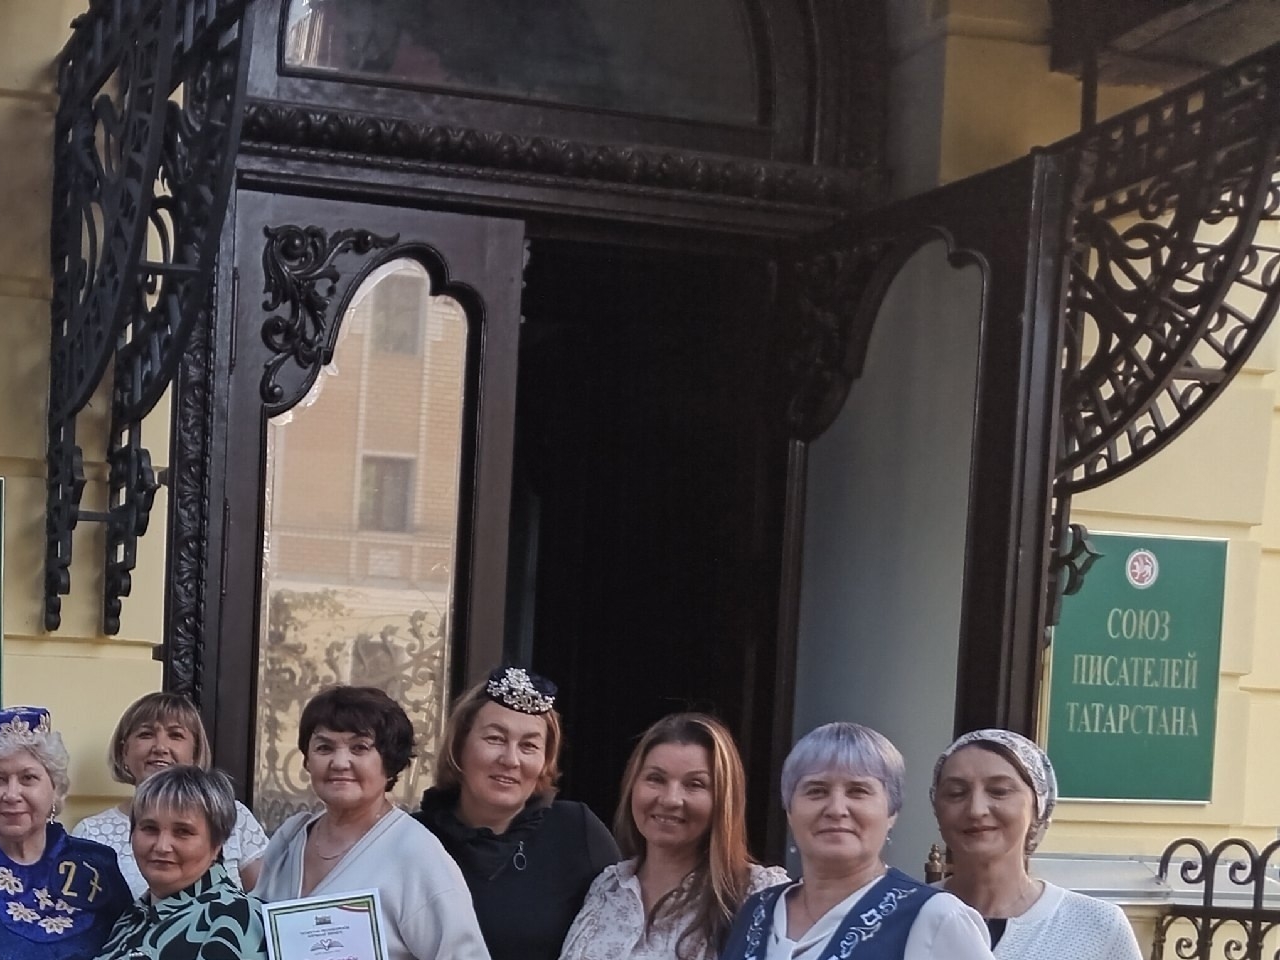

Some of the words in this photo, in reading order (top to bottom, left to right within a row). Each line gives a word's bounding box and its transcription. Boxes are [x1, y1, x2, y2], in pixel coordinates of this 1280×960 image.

[1106, 607, 1171, 642] СОЮЗ
[1071, 652, 1199, 689] ПИСАТЕЛЕЙ
[1066, 702, 1199, 736] ТАТАРСТАНА
